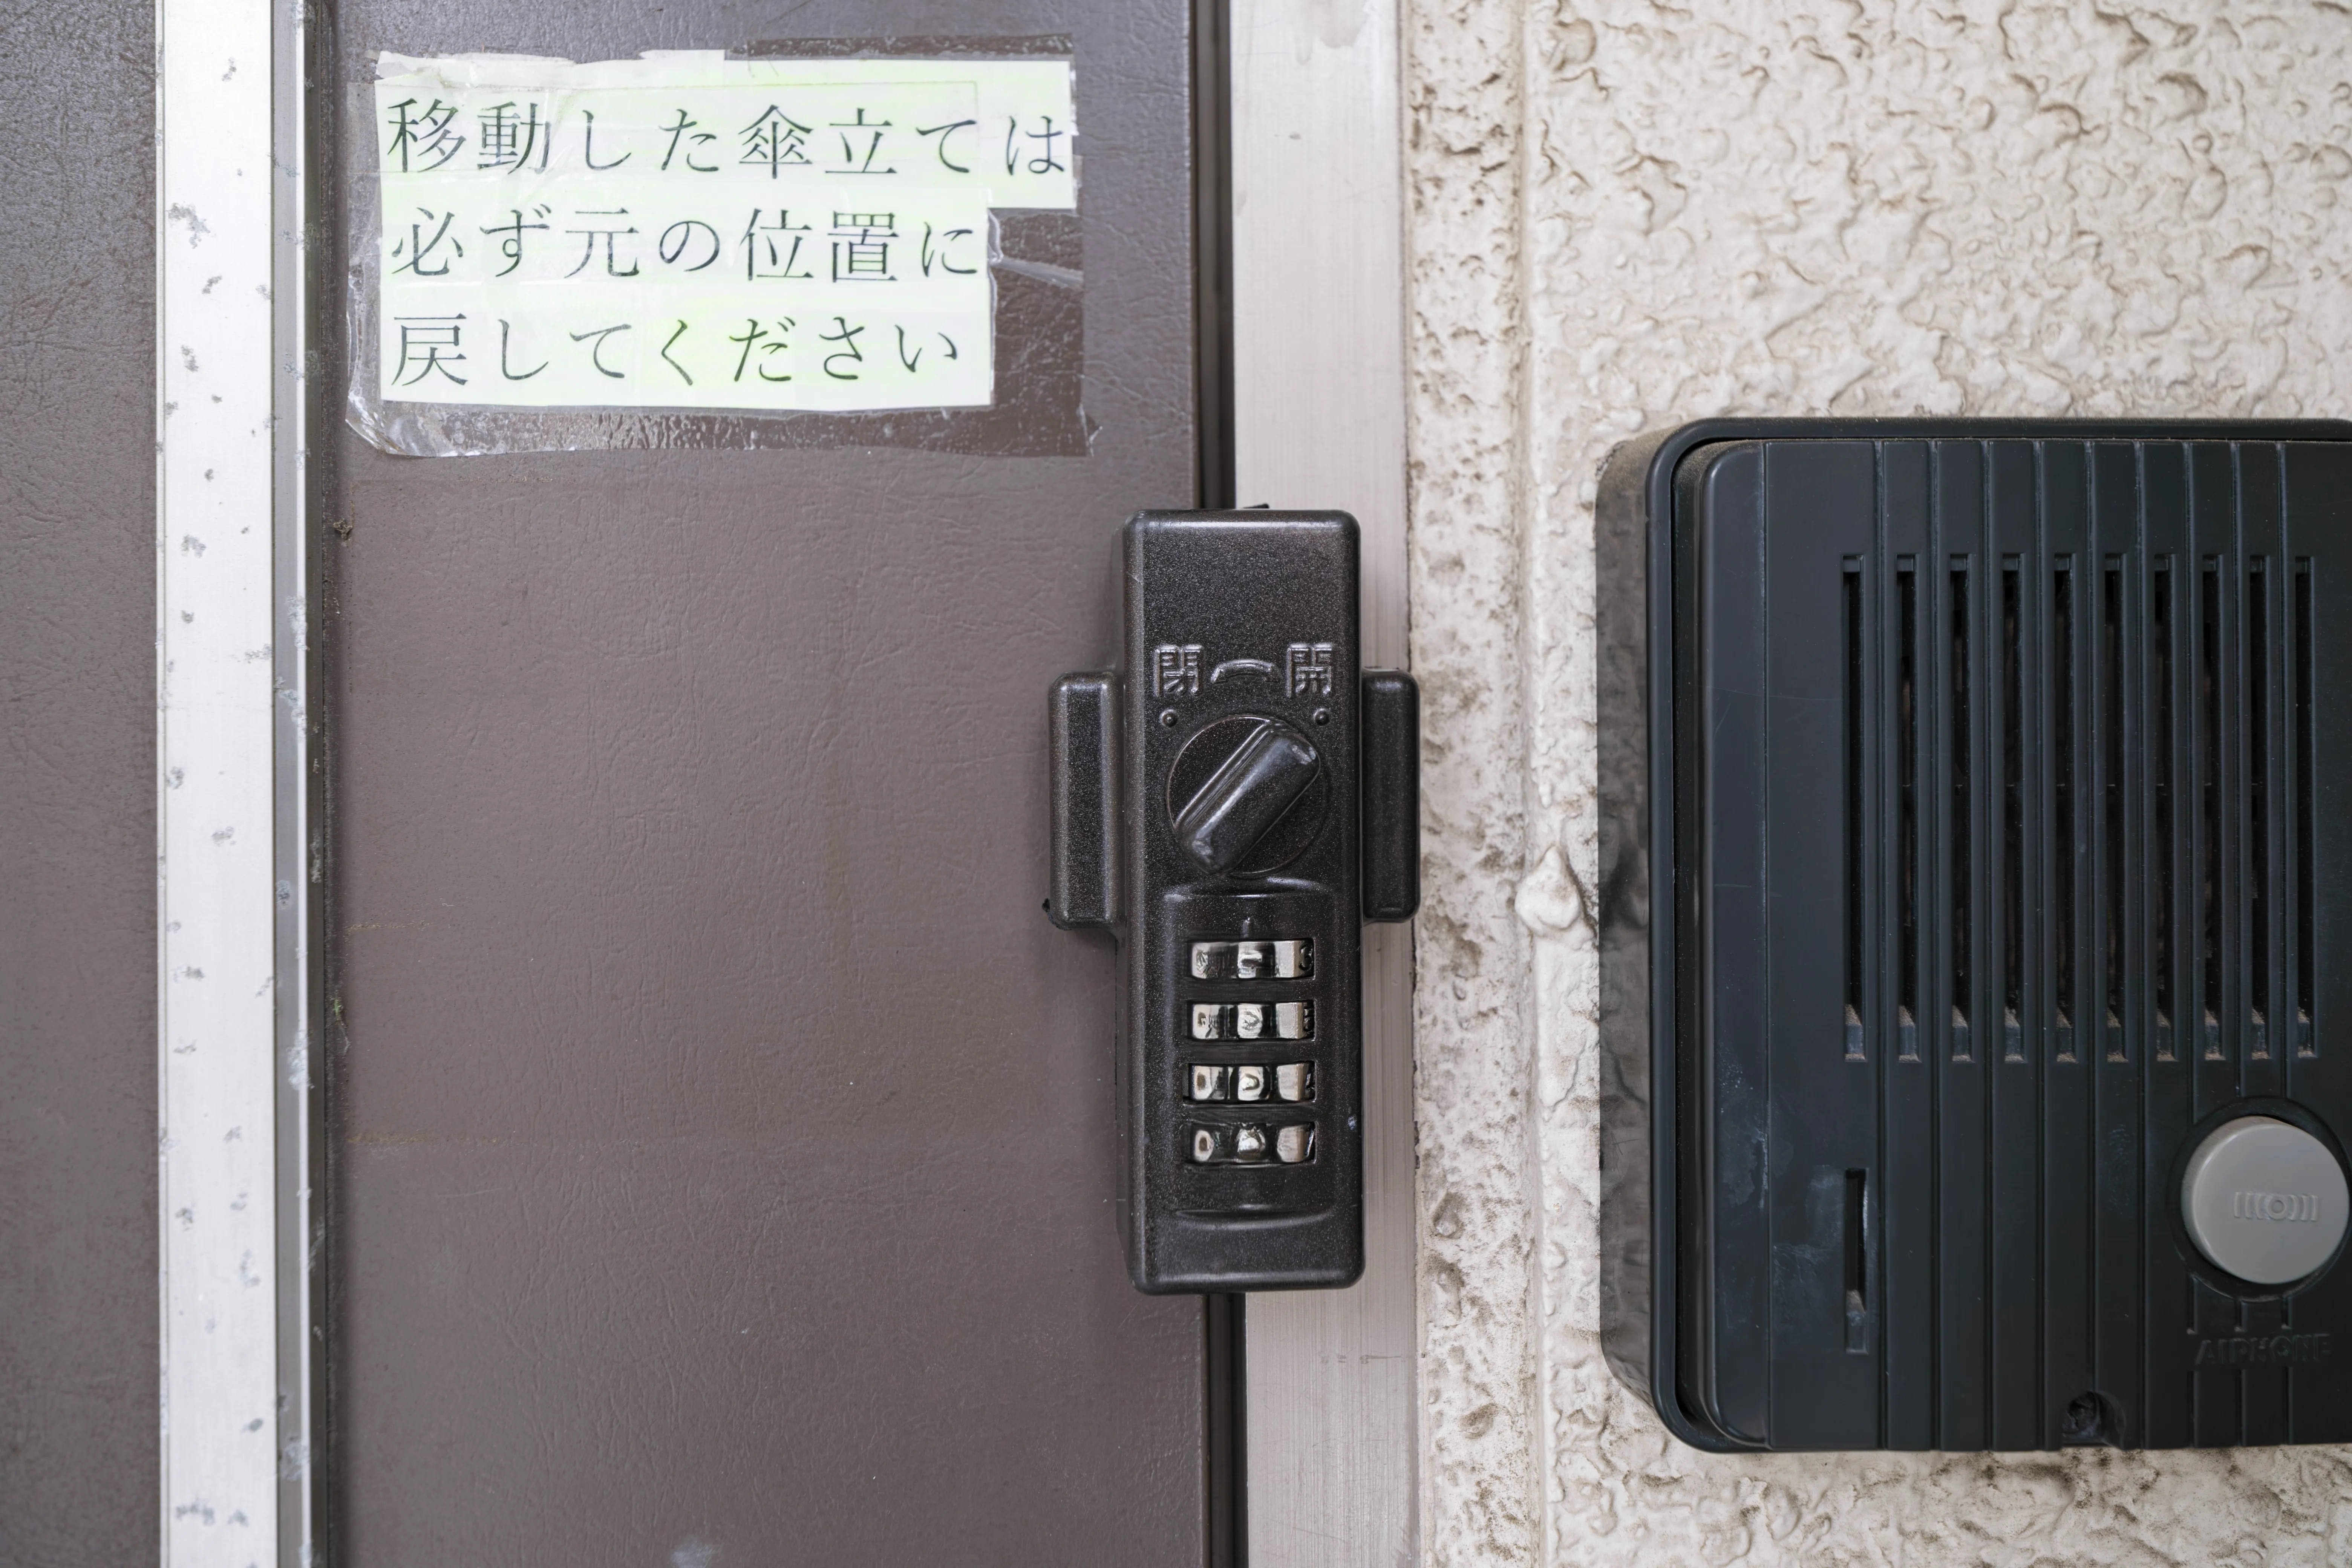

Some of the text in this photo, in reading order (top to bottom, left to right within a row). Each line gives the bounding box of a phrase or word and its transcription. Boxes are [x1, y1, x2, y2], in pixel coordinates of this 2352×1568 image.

[387, 98, 1066, 179] 移動した傘立ては
[390, 204, 978, 283] 必ず元の位置に
[391, 314, 958, 386] 戻してください
[1154, 643, 1205, 697] 閉
[1286, 643, 1334, 698] 開
[2194, 1333, 2333, 1365] AIPHONE
